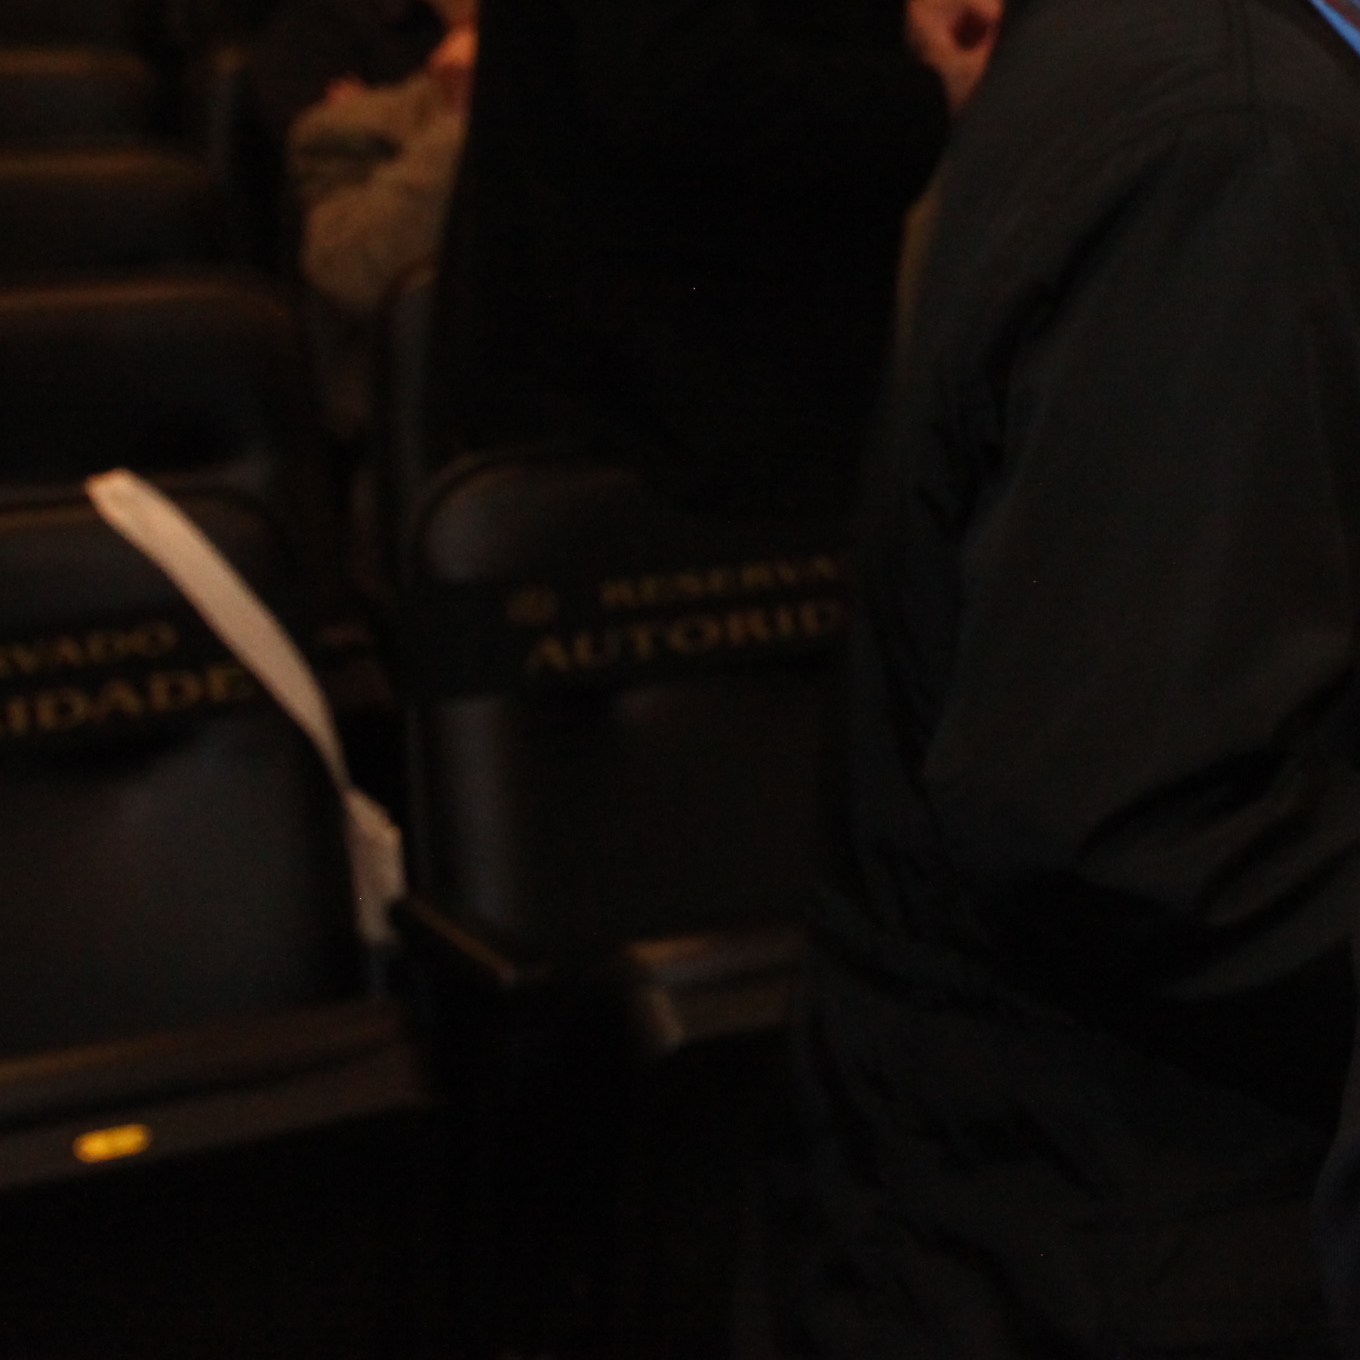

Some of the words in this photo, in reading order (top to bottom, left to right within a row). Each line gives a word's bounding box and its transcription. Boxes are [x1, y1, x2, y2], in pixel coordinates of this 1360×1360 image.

[601, 551, 845, 611] RESERVA
[0, 618, 180, 680] VADO
[524, 596, 849, 677] AUTORID
[0, 660, 256, 738] IDADE
